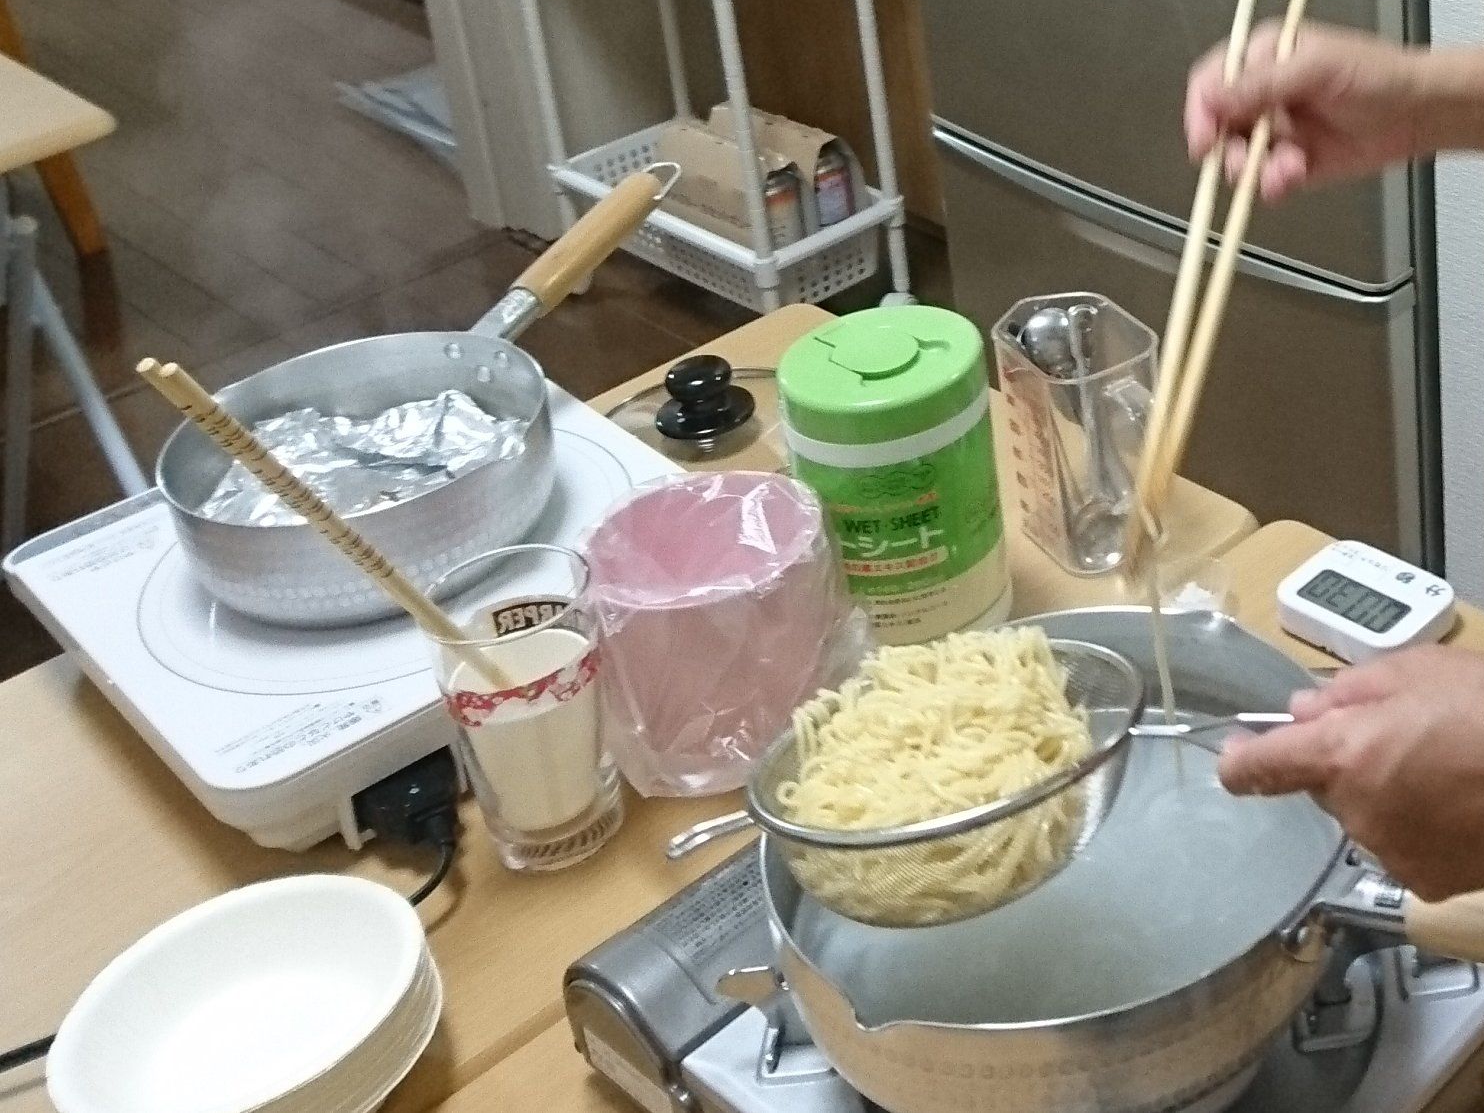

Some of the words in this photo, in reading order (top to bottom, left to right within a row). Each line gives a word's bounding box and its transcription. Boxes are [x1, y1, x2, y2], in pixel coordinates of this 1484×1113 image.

[842, 519, 880, 534] WET
[891, 506, 941, 531] SHEET
[1425, 584, 1447, 597] 分
